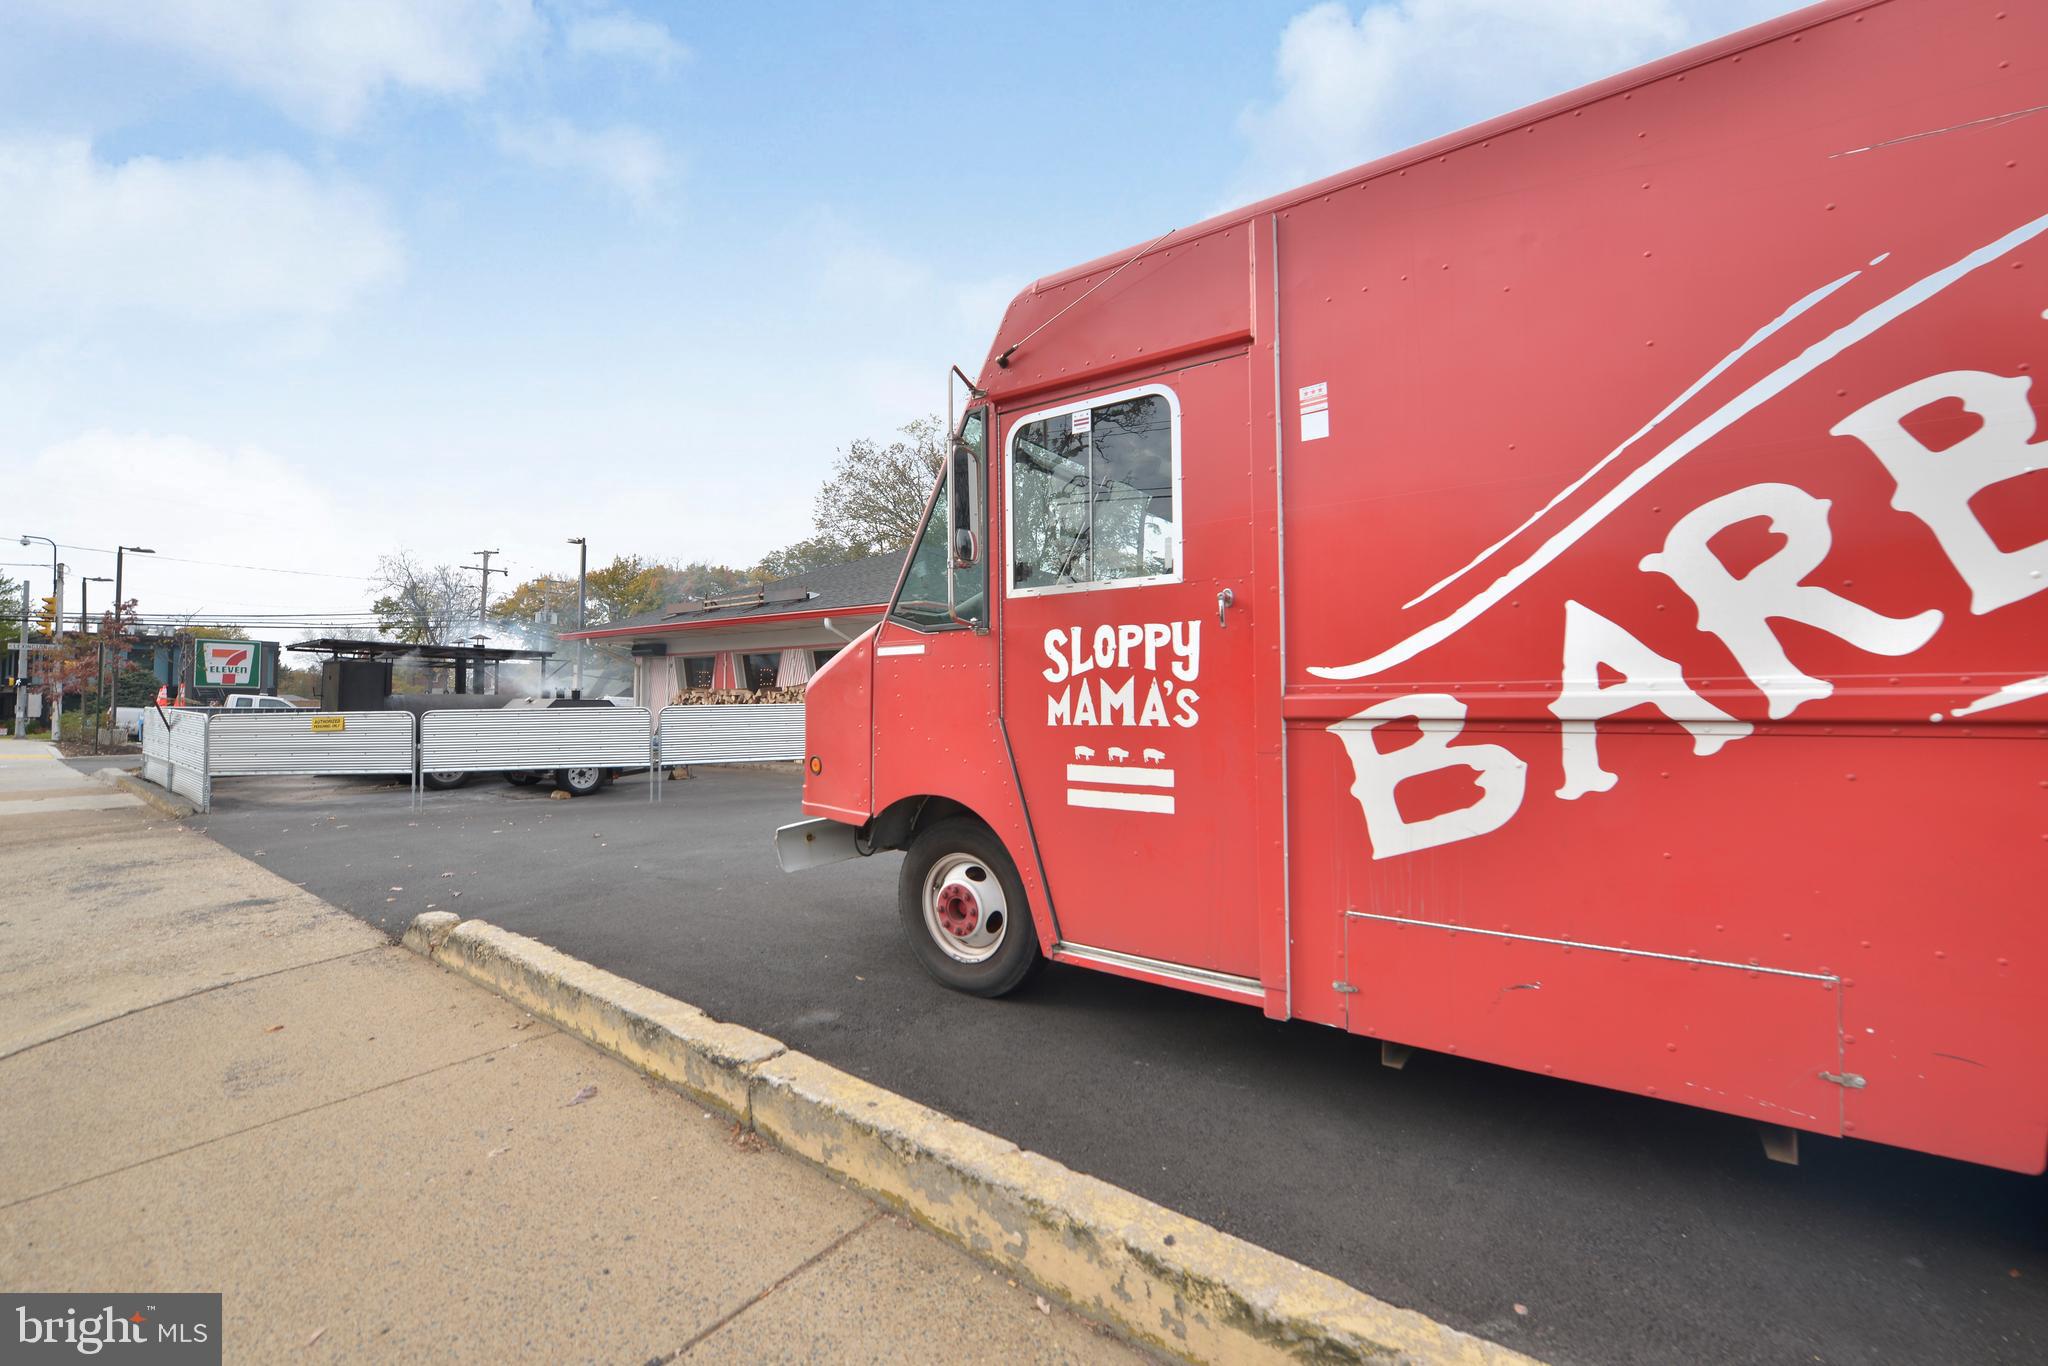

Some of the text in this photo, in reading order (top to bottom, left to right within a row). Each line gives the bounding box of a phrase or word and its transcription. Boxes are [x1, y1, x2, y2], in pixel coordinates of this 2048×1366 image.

[1326, 308, 2048, 860] BARB
[211, 649, 247, 684] 7
[1042, 620, 1201, 682] SLOPPY
[1047, 675, 1200, 728] MAMA'S
